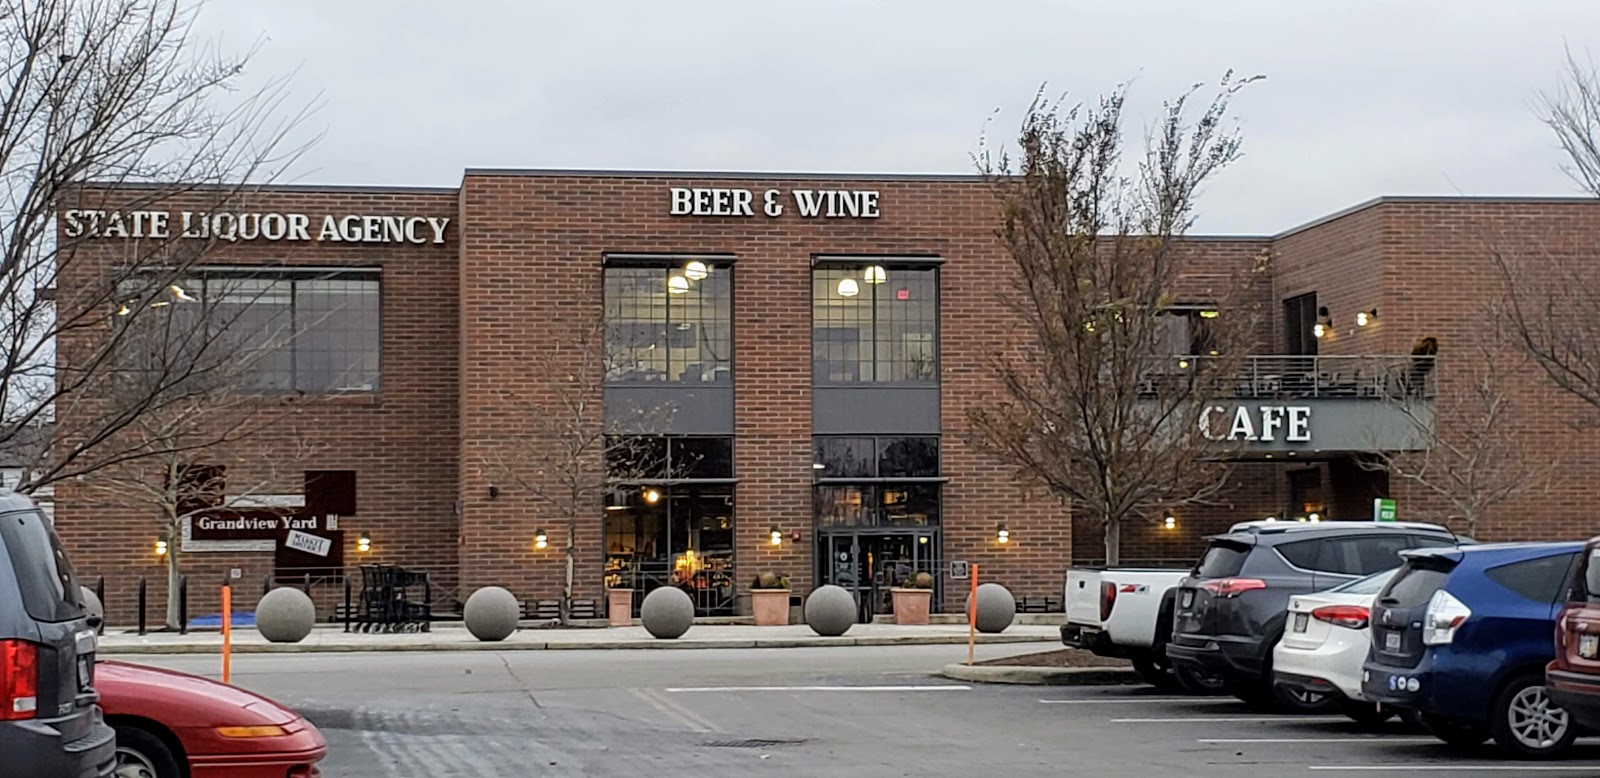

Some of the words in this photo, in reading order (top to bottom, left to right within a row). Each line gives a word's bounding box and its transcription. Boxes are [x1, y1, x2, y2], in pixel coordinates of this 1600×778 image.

[669, 187, 754, 216] BEER
[763, 188, 784, 217] &
[792, 189, 880, 218] WINE
[64, 209, 170, 238] STATE
[181, 211, 311, 241] LIQUOR
[316, 214, 450, 244] AGENCY
[1198, 405, 1311, 441] CAFE
[199, 517, 278, 530] Grandview
[282, 516, 318, 530] Yard
